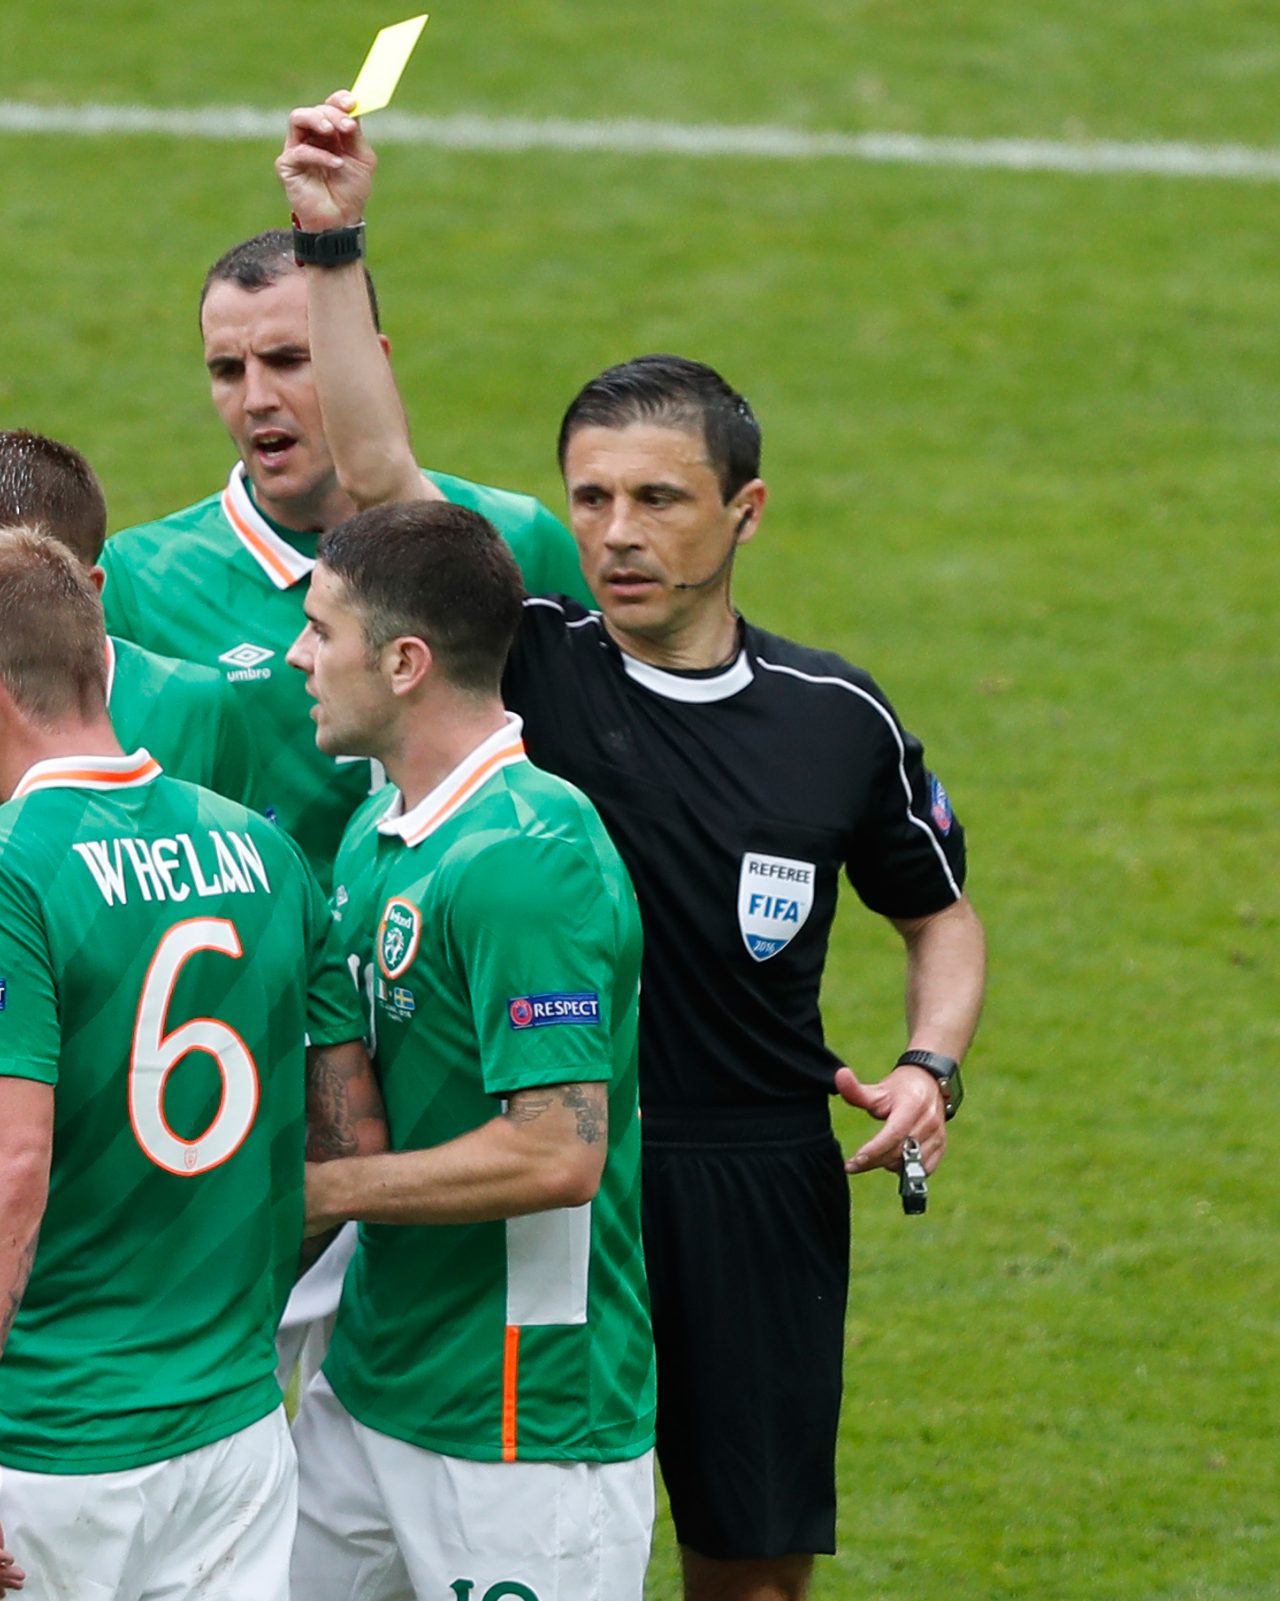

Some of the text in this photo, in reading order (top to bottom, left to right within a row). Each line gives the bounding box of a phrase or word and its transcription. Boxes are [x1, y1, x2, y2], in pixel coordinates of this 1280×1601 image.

[227, 668, 271, 682] umbro
[72, 831, 271, 906] WHELAN
[749, 861, 812, 884] REFEREE
[748, 893, 799, 922] FIFA
[533, 1001, 598, 1017] RESPECT
[128, 916, 261, 1177] 6
